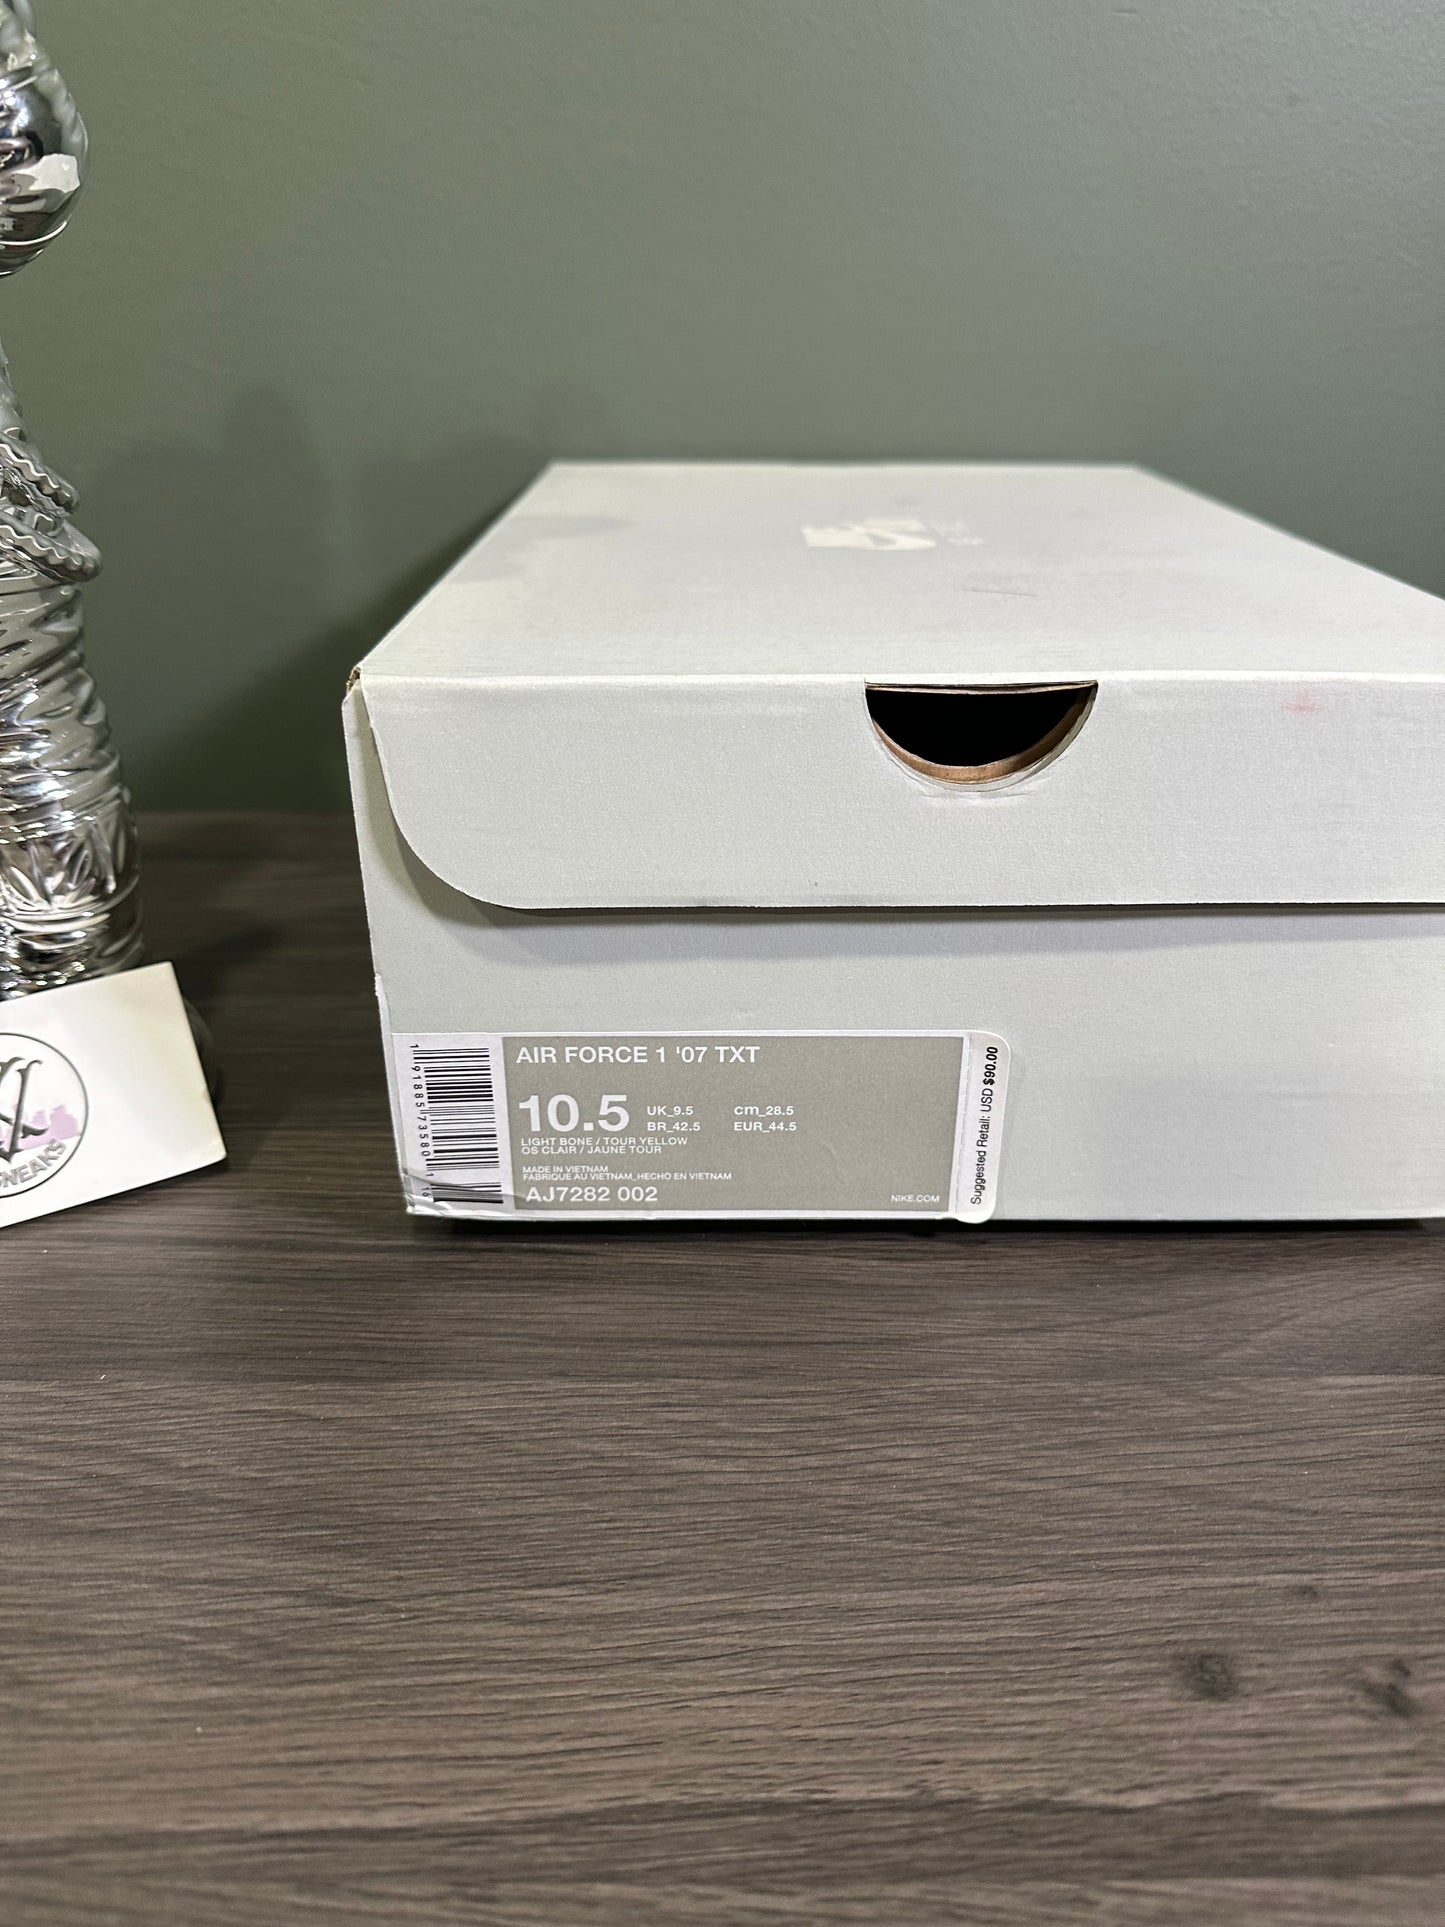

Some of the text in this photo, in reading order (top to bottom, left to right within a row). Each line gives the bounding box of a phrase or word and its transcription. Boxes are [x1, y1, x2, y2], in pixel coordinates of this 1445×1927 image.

[516, 1046, 761, 1063] AIR FORCE 1 '07 TXT
[519, 1094, 630, 1132] 10.5
[647, 1106, 694, 1117] UK_9.5
[733, 1105, 795, 1117] cm_28.5
[647, 1121, 701, 1133] BR_42.5
[733, 1121, 797, 1133] EUR_44.5
[970, 1046, 999, 1205] Suggested Retail: USD $90.00
[521, 1137, 556, 1146] LIGHT
[559, 1137, 593, 1146] BONE
[602, 1137, 636, 1146] TOUR
[639, 1137, 688, 1146] YELLOW
[521, 1146, 539, 1155] OS
[541, 1146, 577, 1155] CLAIR
[587, 1146, 626, 1154] JAUNE
[629, 1145, 662, 1154] TOUR
[522, 1165, 609, 1174] MADE IN VIETNAM
[523, 1173, 572, 1181] FABRIQUE
[673, 1172, 687, 1180] EN
[689, 1172, 732, 1180] VIETNAM
[526, 1186, 658, 1202] AJ7282 002
[891, 1194, 940, 1203] NIKE.COM
